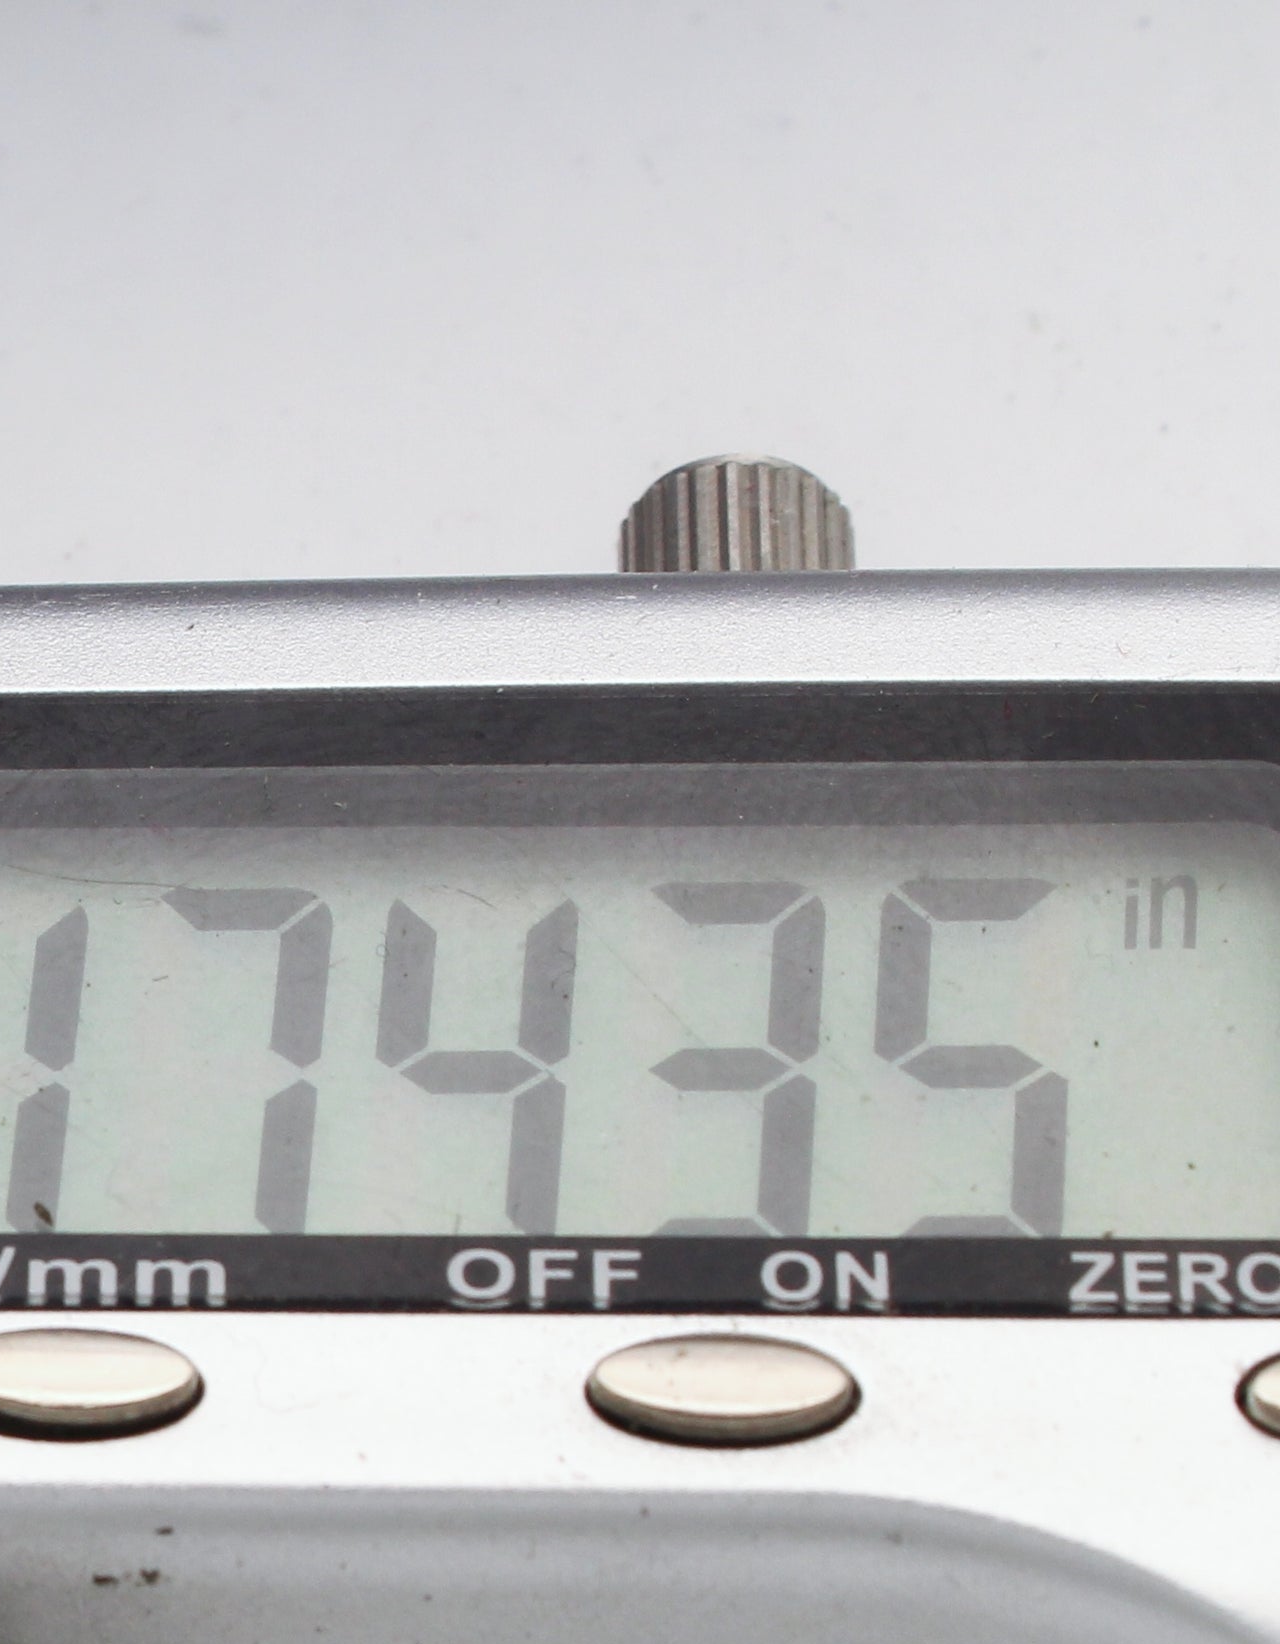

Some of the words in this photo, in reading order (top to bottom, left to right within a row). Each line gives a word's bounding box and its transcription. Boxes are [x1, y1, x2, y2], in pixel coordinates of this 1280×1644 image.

[1121, 866, 1202, 951] in
[445, 1247, 643, 1308] OFF
[759, 1250, 891, 1309] ON
[1067, 1250, 1280, 1312] ZERO
